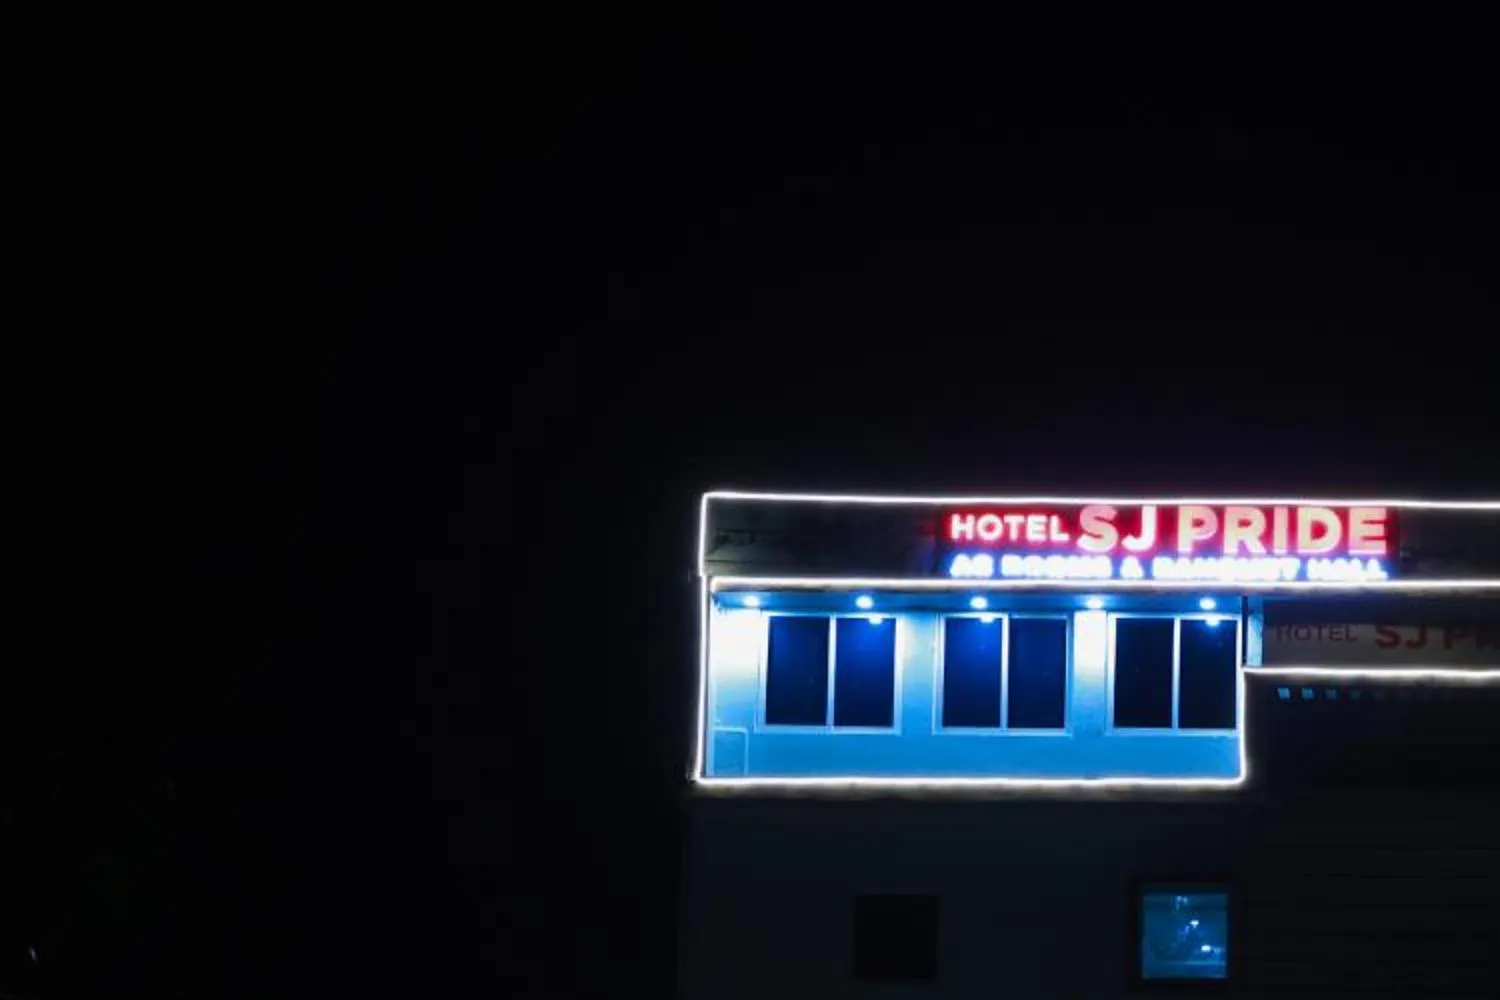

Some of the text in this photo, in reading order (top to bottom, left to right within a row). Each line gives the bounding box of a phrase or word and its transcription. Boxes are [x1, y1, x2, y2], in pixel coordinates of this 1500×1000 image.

[951, 505, 1387, 555] HOTEL SJ PRIDE
[1275, 623, 1357, 642] HOTEL
[1374, 622, 1428, 649] SJ
